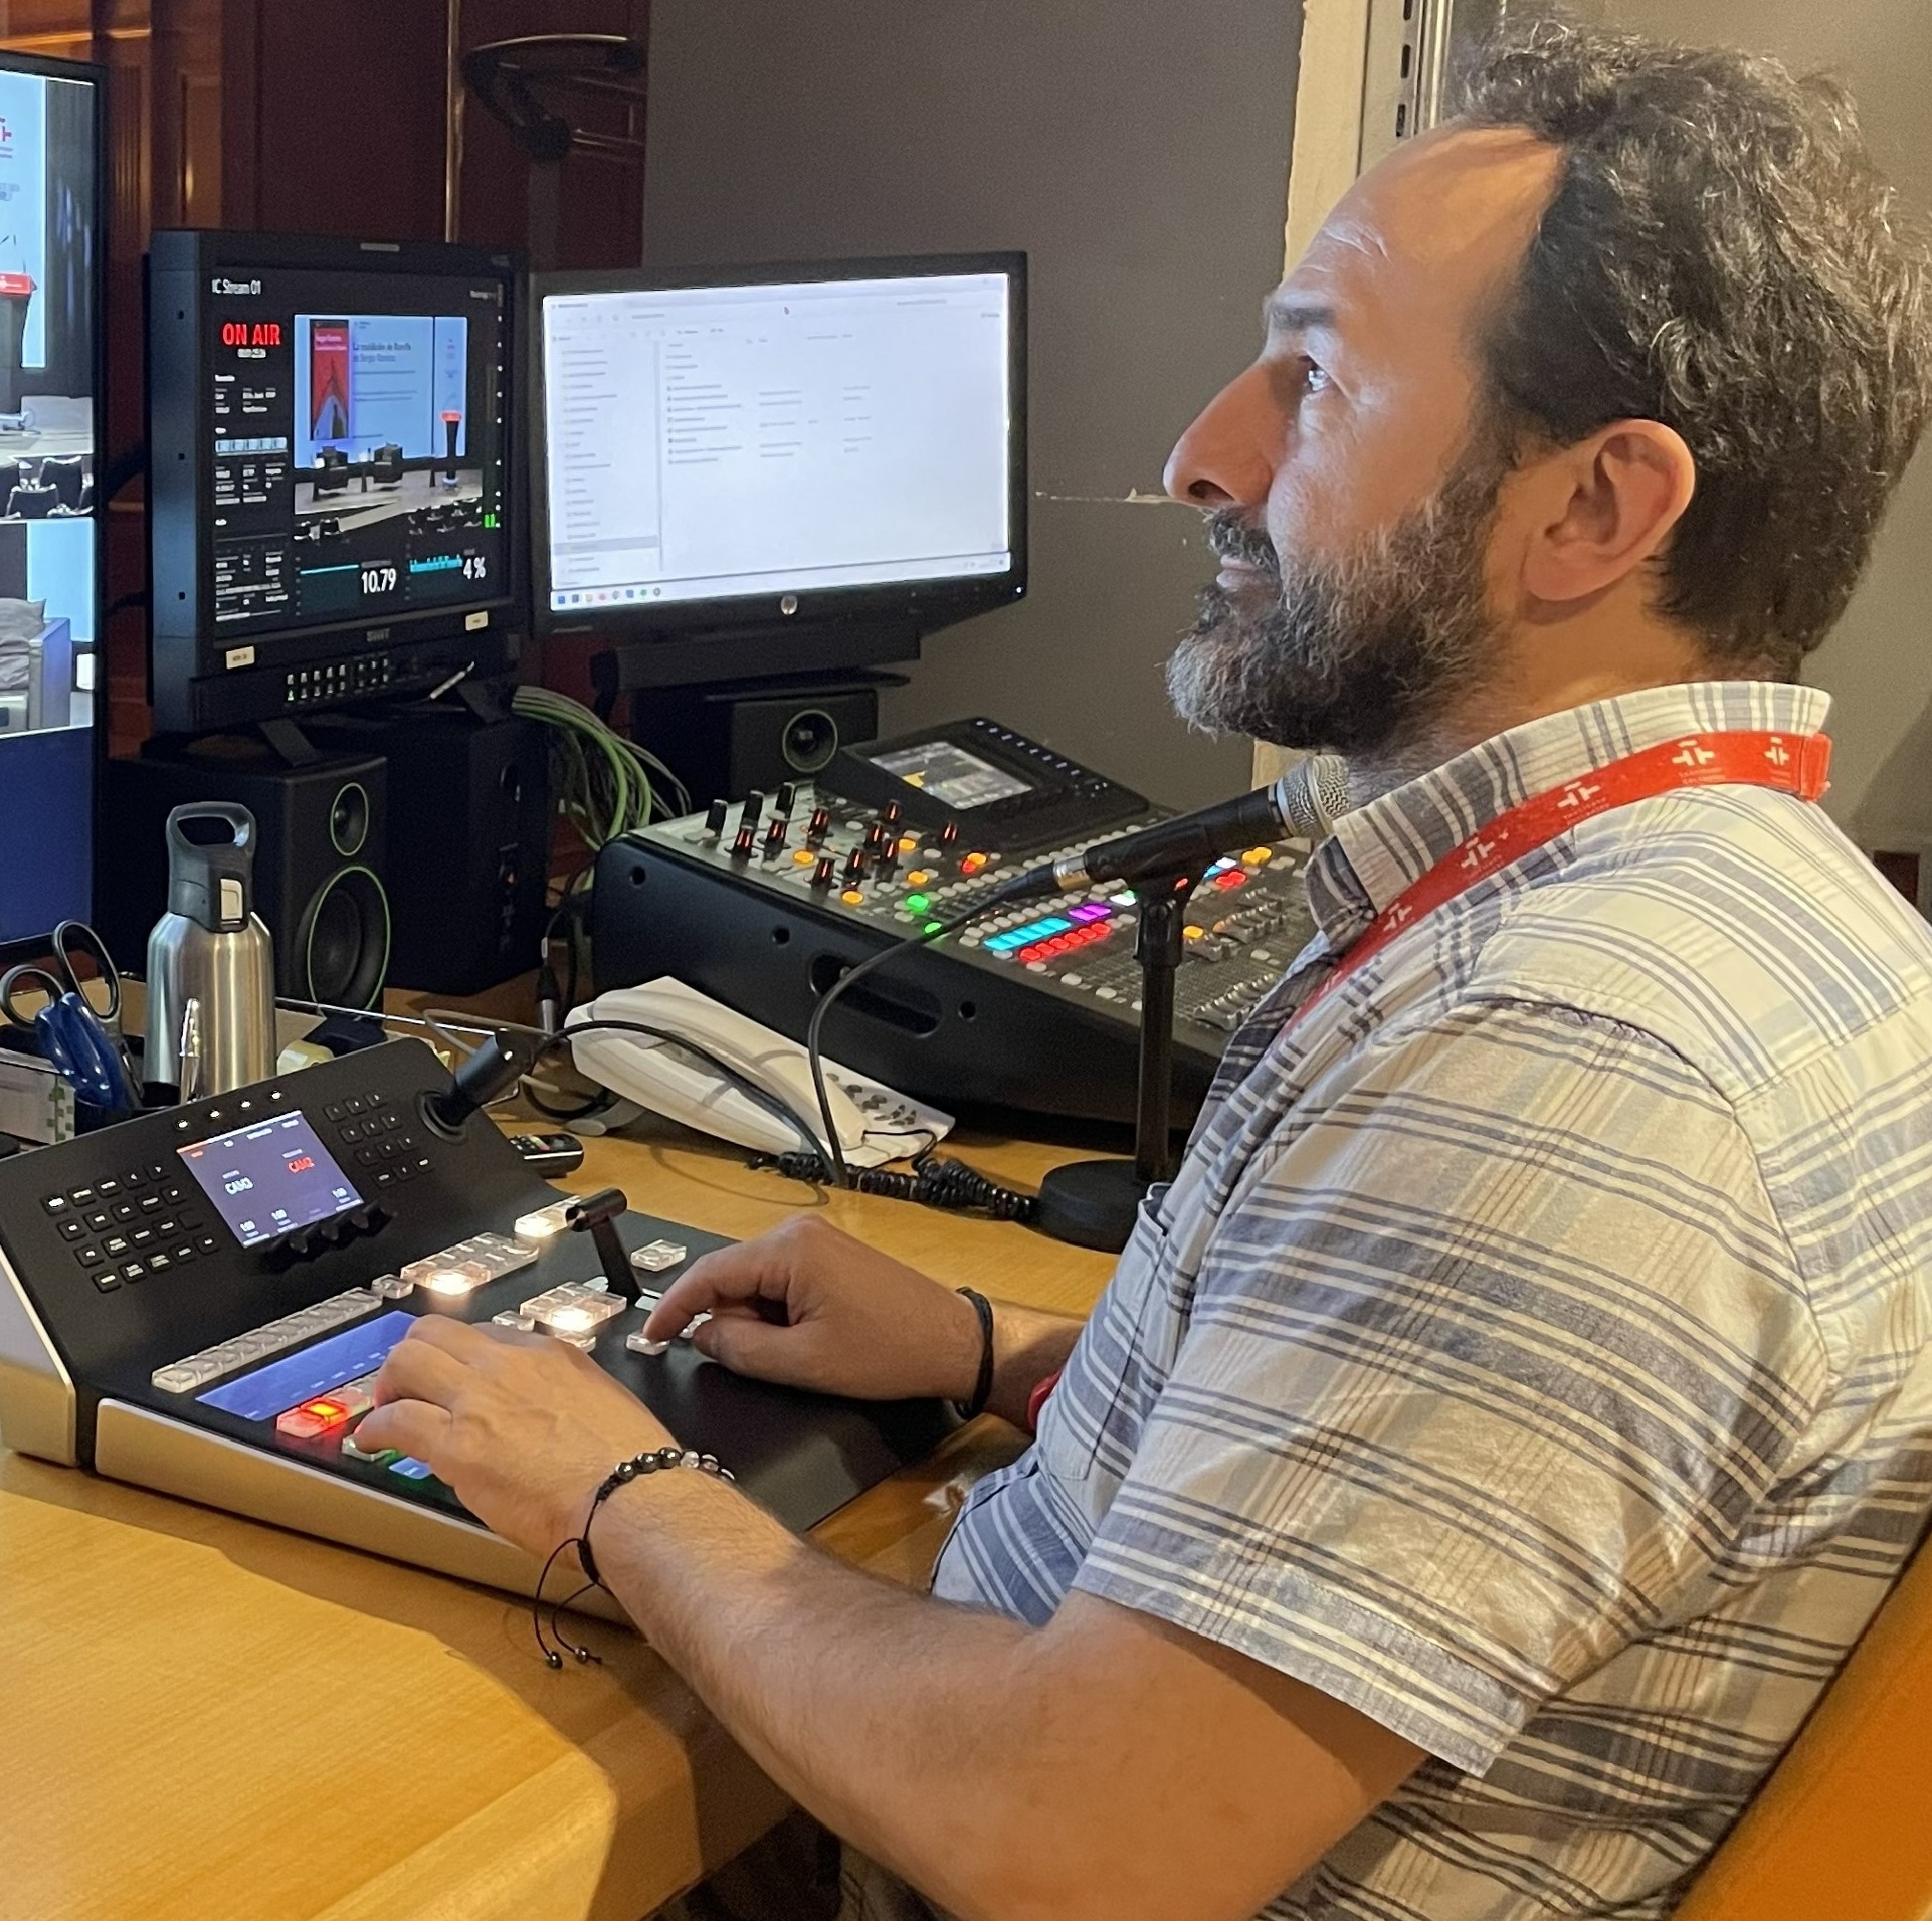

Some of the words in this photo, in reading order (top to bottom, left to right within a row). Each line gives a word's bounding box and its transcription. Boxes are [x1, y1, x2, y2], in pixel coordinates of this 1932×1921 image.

[222, 323, 247, 346] ON
[252, 324, 281, 346] AIR
[361, 568, 396, 593] 10.79
